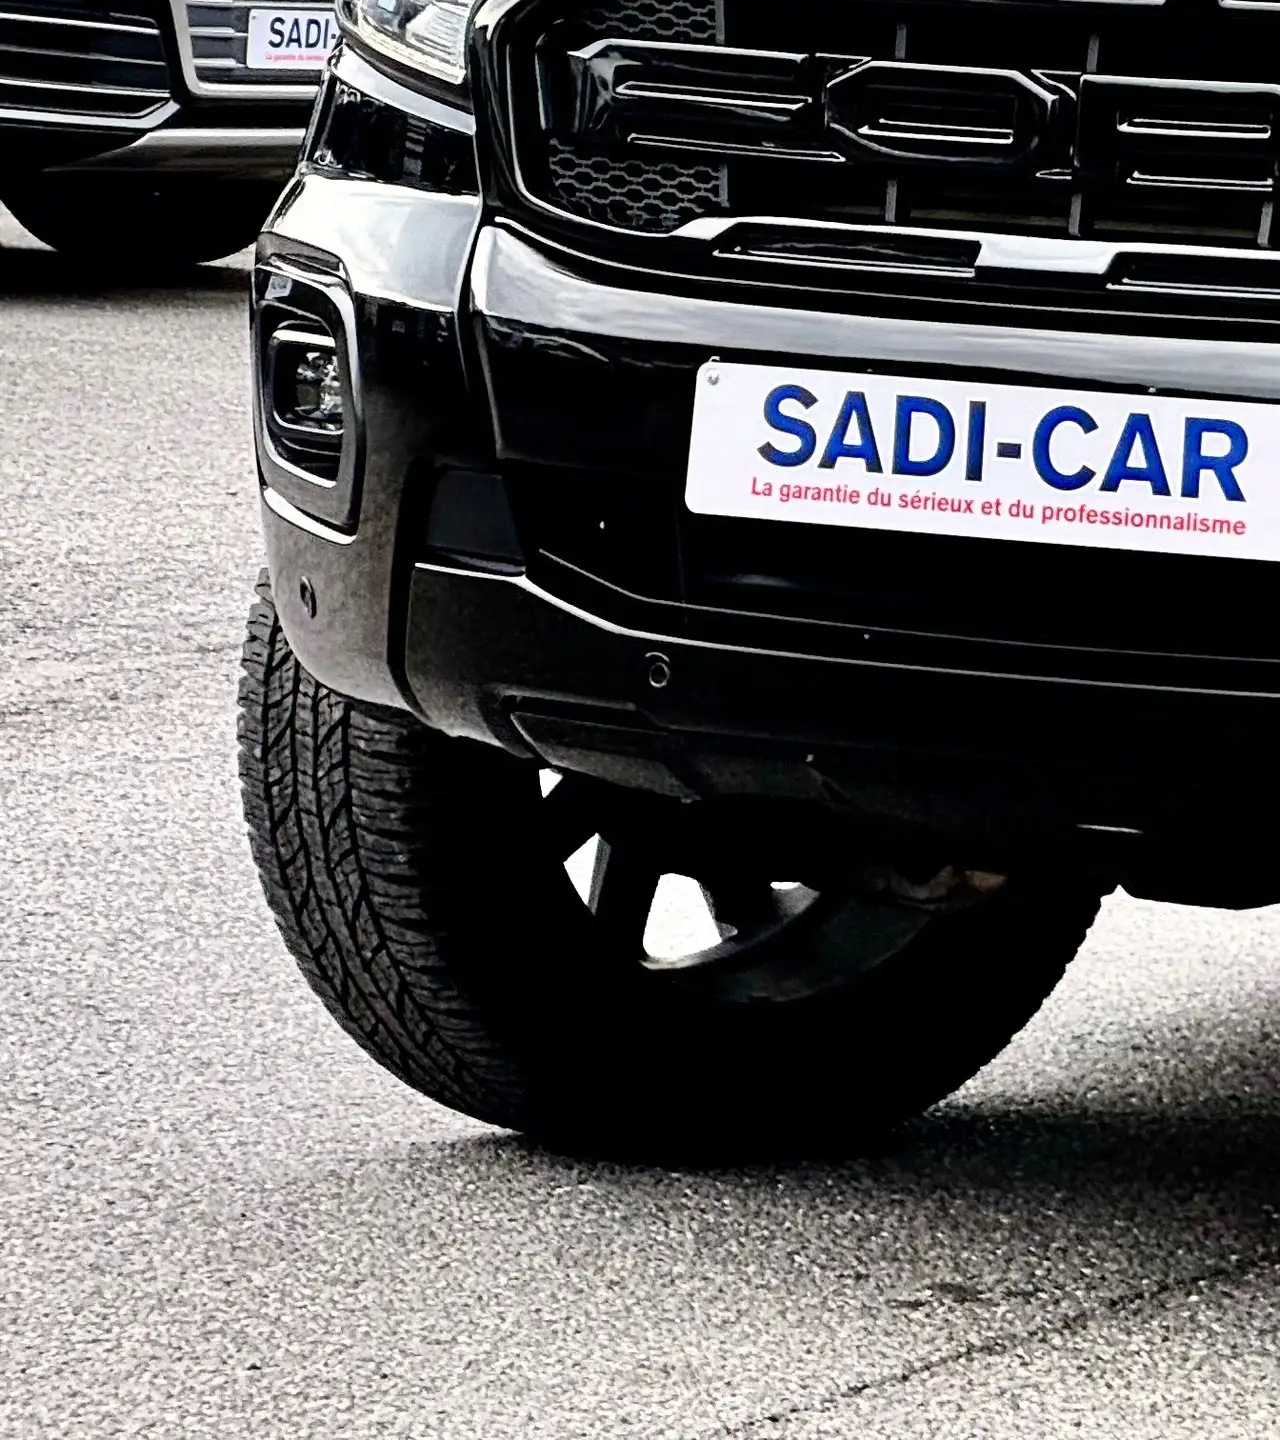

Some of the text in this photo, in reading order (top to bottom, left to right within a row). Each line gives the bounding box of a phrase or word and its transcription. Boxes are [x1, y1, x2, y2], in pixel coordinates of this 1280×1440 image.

[757, 384, 1249, 502] SADI-CAR
[751, 476, 1247, 537] La garantie du sérieux et du professionnalisme
